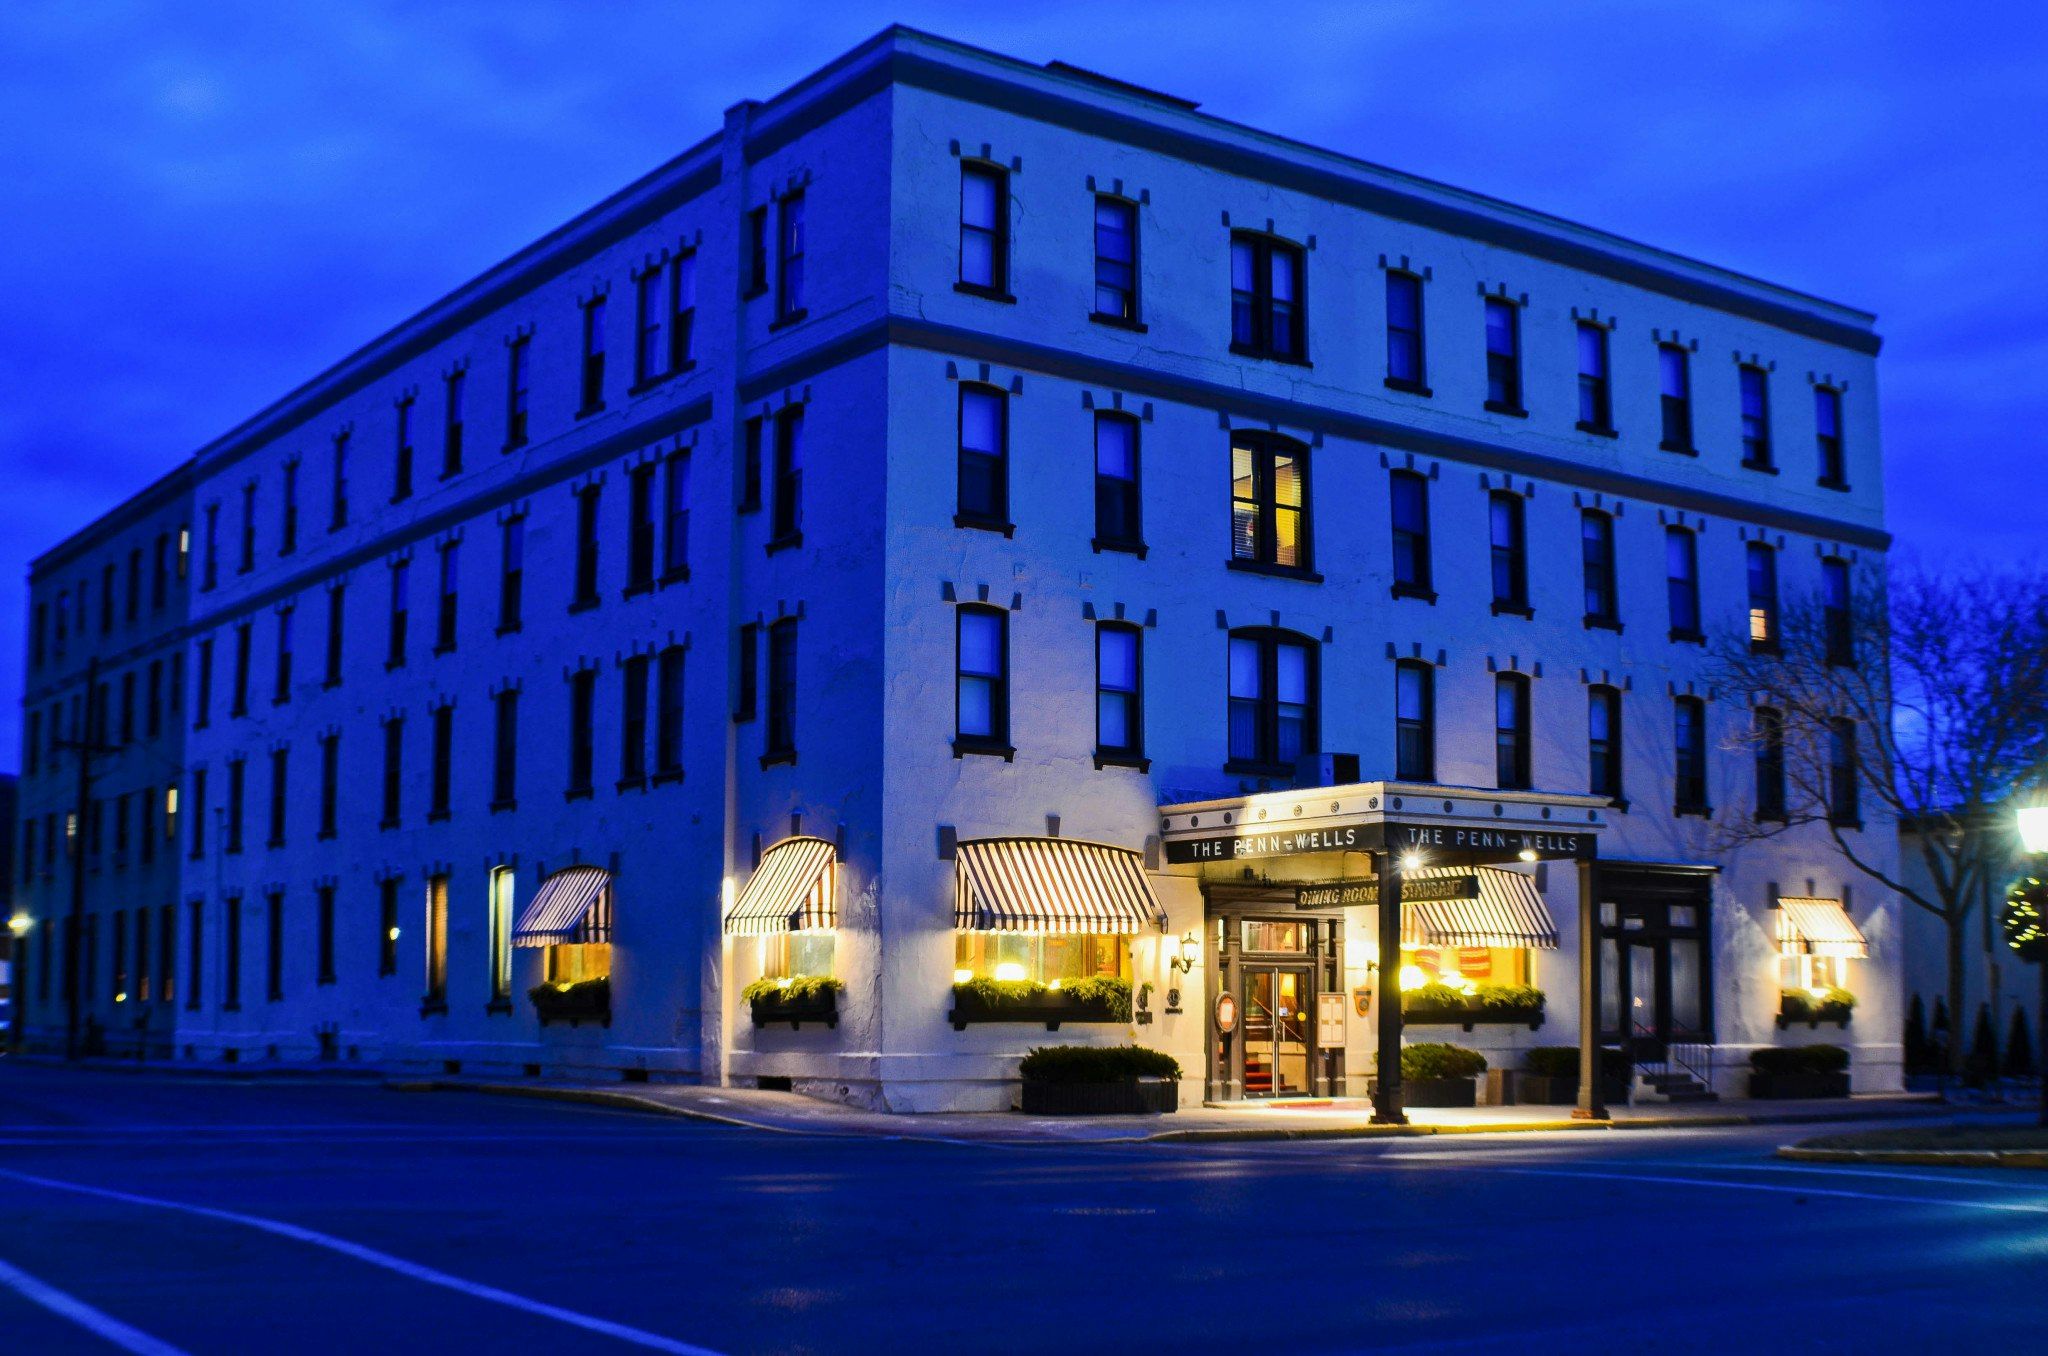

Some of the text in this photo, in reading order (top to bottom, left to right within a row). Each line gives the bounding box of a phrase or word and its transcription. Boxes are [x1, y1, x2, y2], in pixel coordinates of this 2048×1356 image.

[1192, 829, 1356, 857] THE PENN-WELLS
[1408, 828, 1578, 851] THE PENN-WELLS
[1300, 888, 1340, 905] DINING
[1400, 879, 1463, 899] STAURANT
